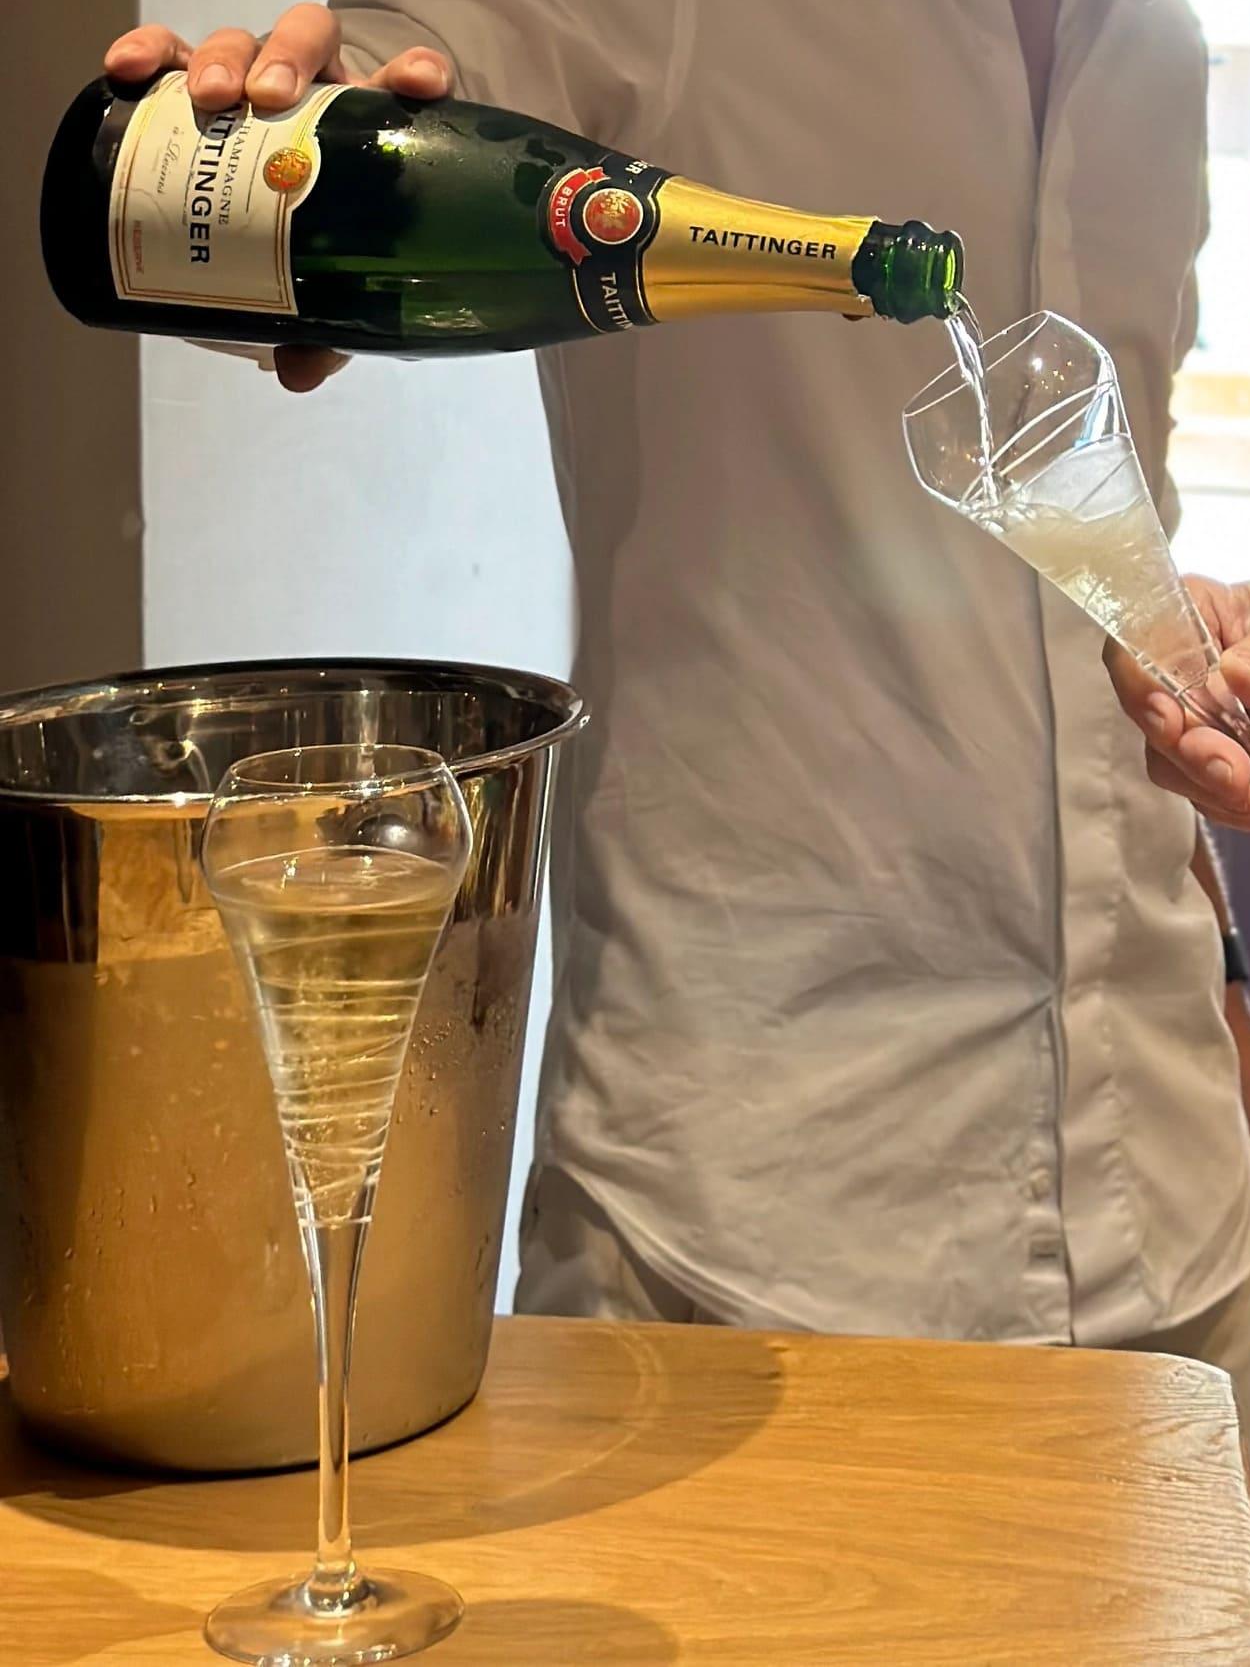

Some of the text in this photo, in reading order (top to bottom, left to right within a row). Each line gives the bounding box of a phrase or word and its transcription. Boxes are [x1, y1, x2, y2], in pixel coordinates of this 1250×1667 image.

[189, 103, 241, 264] ITTINGER
[555, 187, 574, 227] BRUT
[689, 226, 836, 261] TAITTINGER
